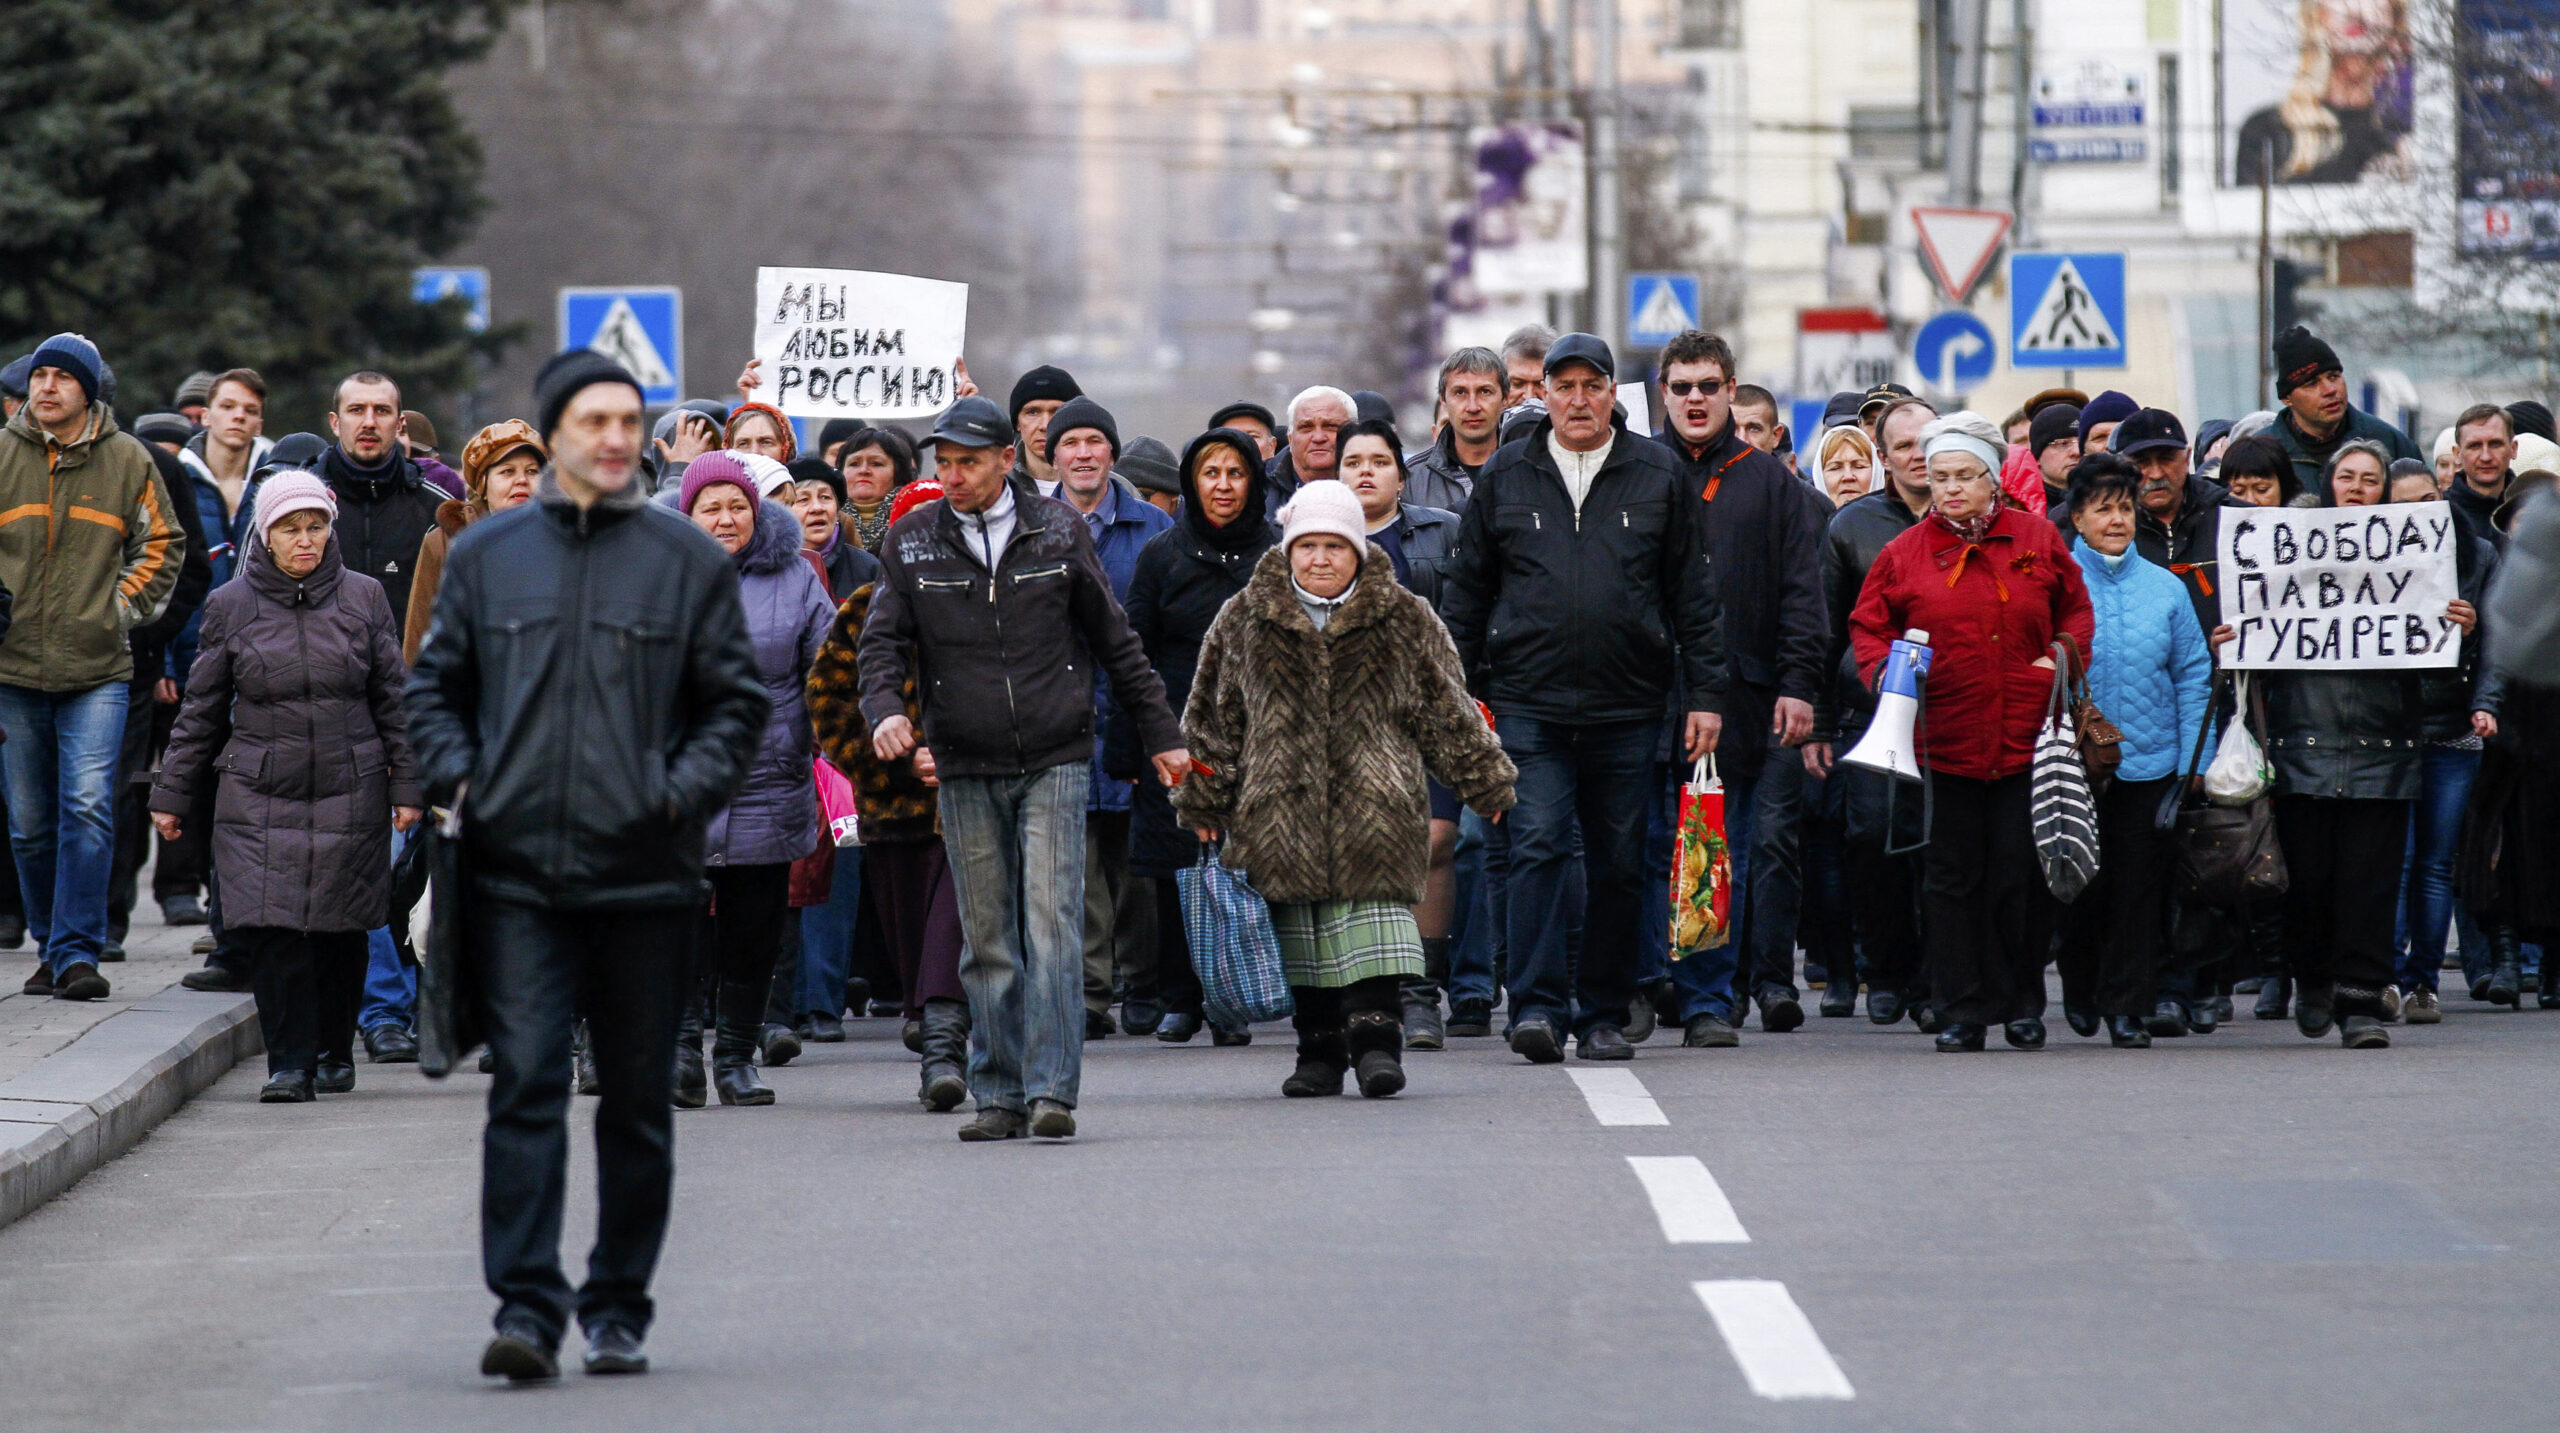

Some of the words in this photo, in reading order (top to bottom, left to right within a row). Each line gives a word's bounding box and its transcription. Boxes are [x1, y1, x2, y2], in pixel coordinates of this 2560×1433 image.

[774, 282, 847, 324] МЫ
[780, 327, 905, 361] ЛЮБИМ
[2233, 514, 2450, 570] СВОБОДУ
[2238, 570, 2414, 613] ПАВЛУ
[2237, 613, 2457, 662] ГУБАРЕВУ
